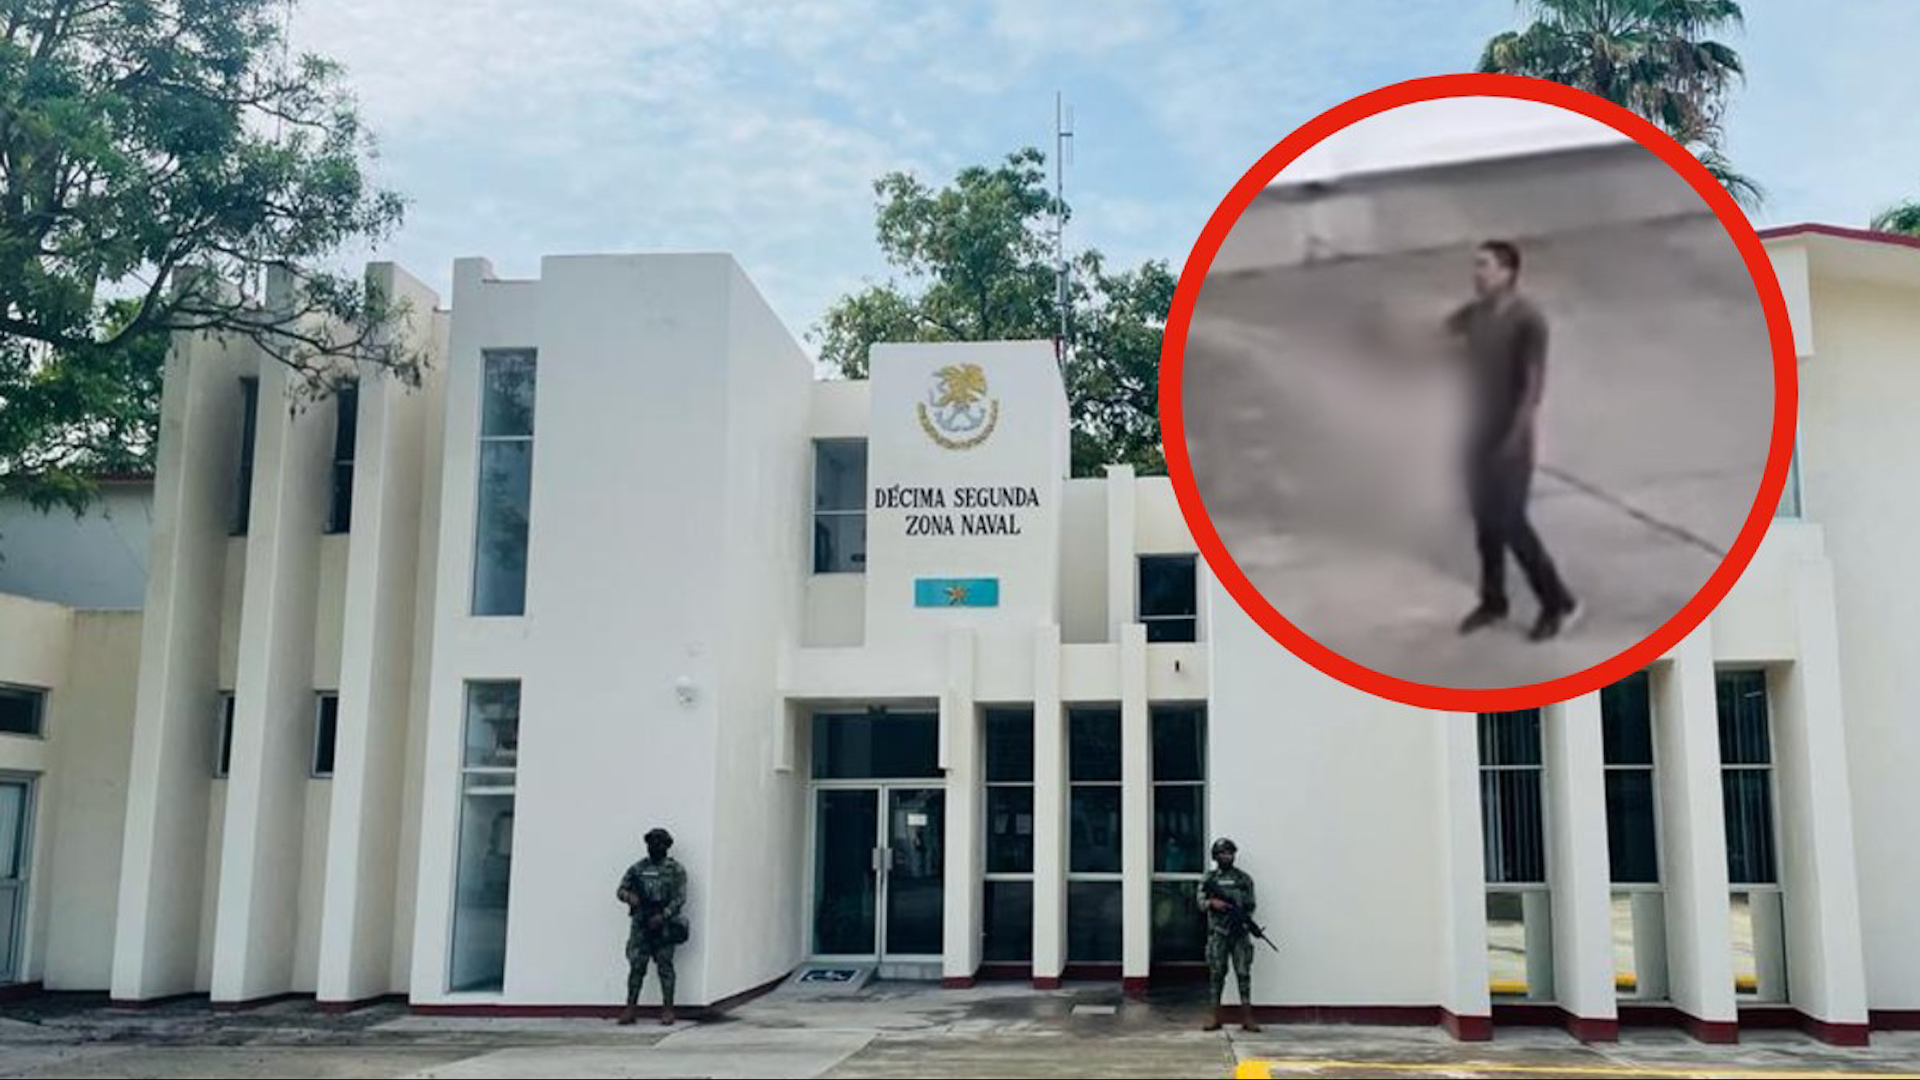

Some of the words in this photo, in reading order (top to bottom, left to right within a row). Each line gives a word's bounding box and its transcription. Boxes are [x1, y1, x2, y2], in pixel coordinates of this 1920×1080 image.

[874, 484, 946, 509] DÉCIMA
[953, 486, 1040, 508] SEGUNDA
[905, 515, 954, 536] ZONA
[961, 514, 1021, 536] NAVAL
